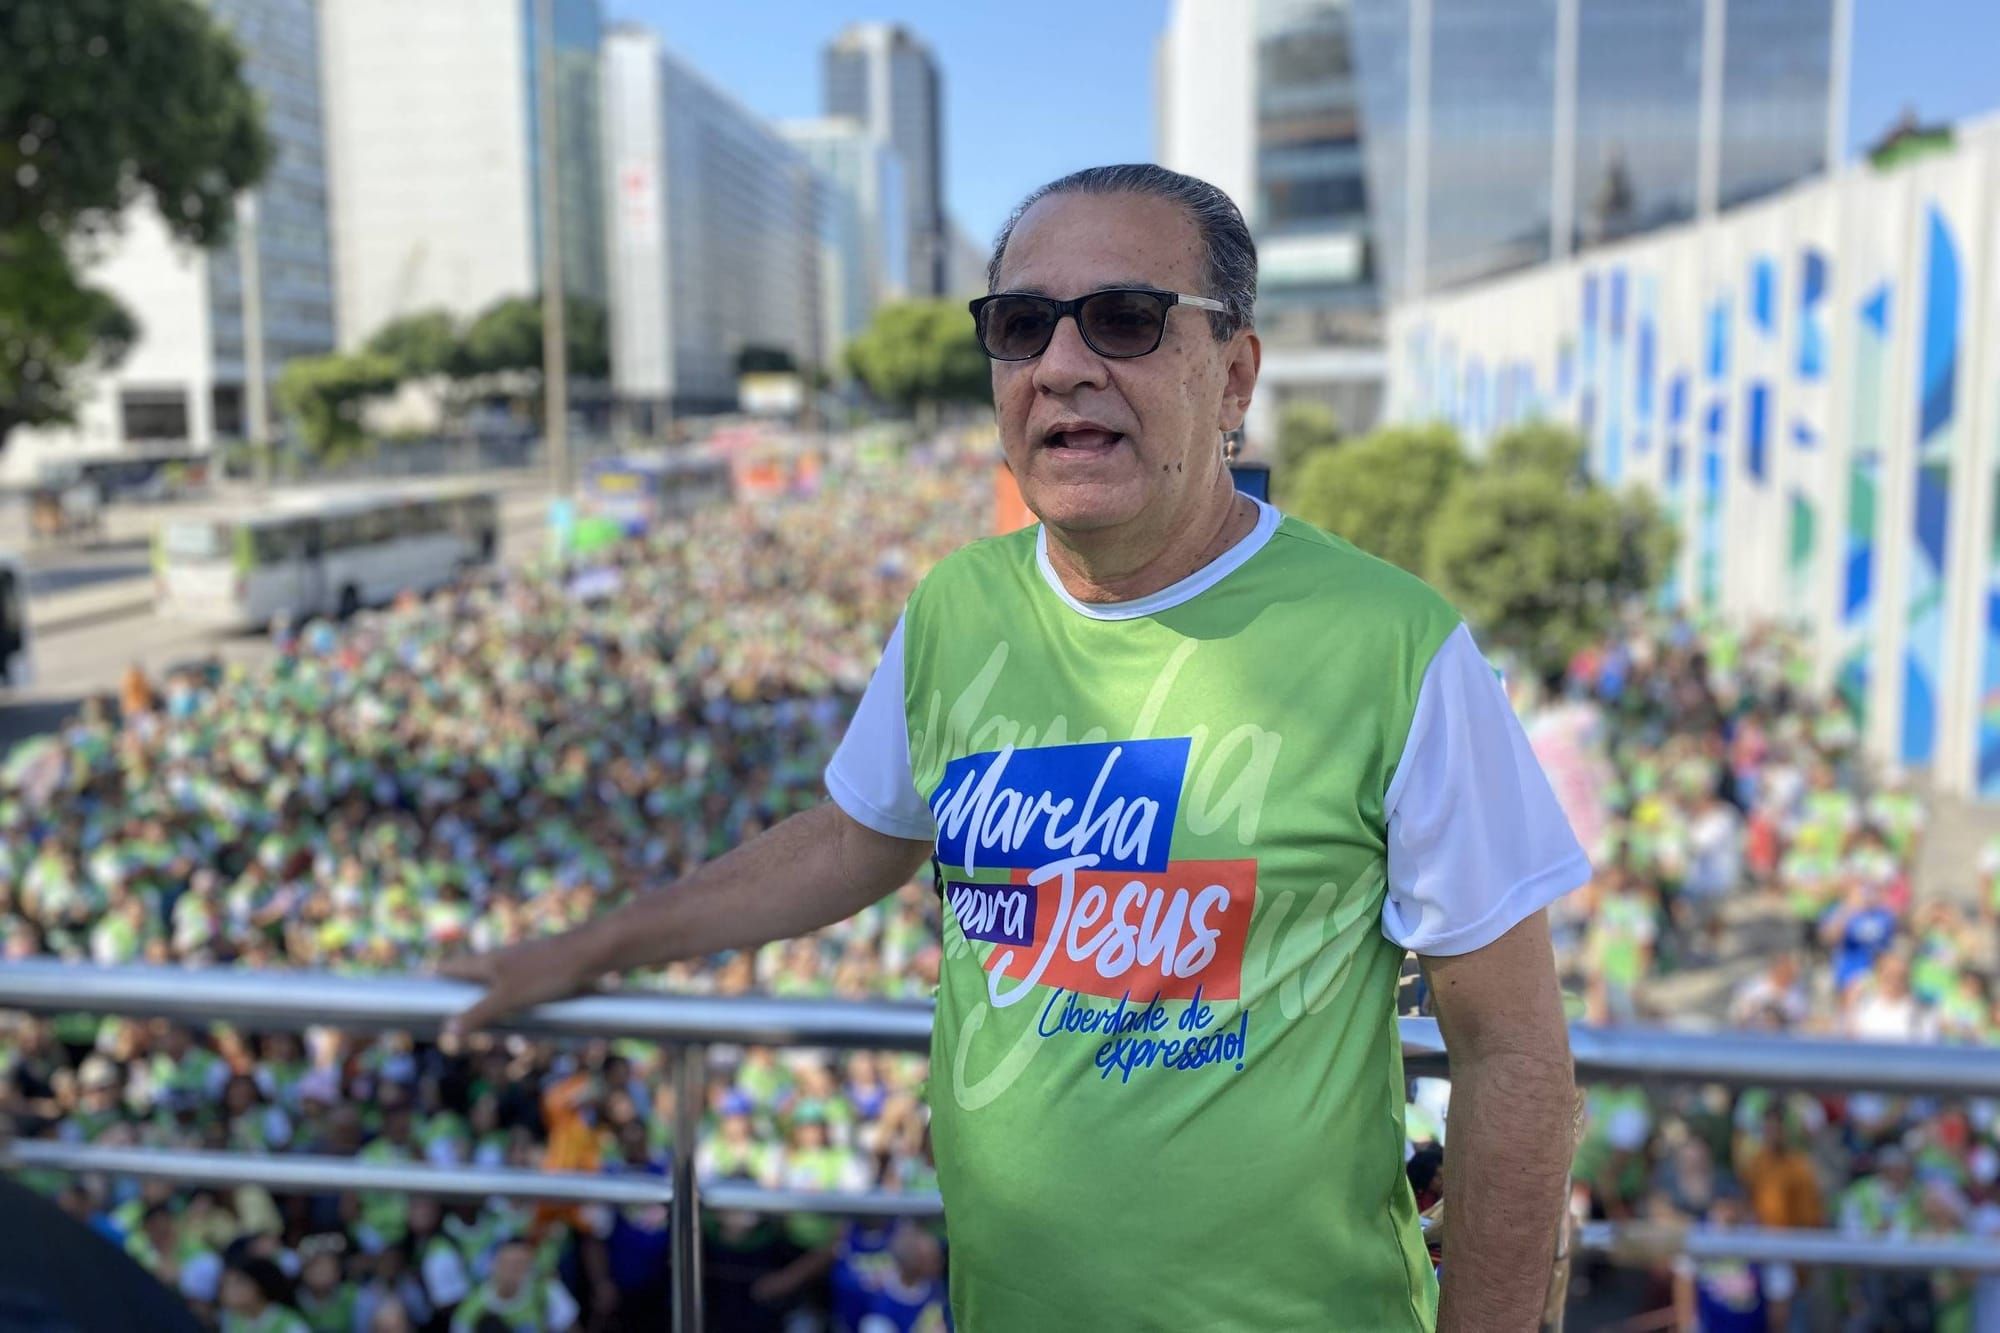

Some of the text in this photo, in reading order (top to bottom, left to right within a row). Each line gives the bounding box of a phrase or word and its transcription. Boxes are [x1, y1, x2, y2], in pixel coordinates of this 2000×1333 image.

[934, 742, 1159, 878] Marcha
[987, 853, 1231, 1009] Jesus
[1037, 983, 1215, 1038] Liberdade de
[1094, 1009, 1249, 1084] expressão!
